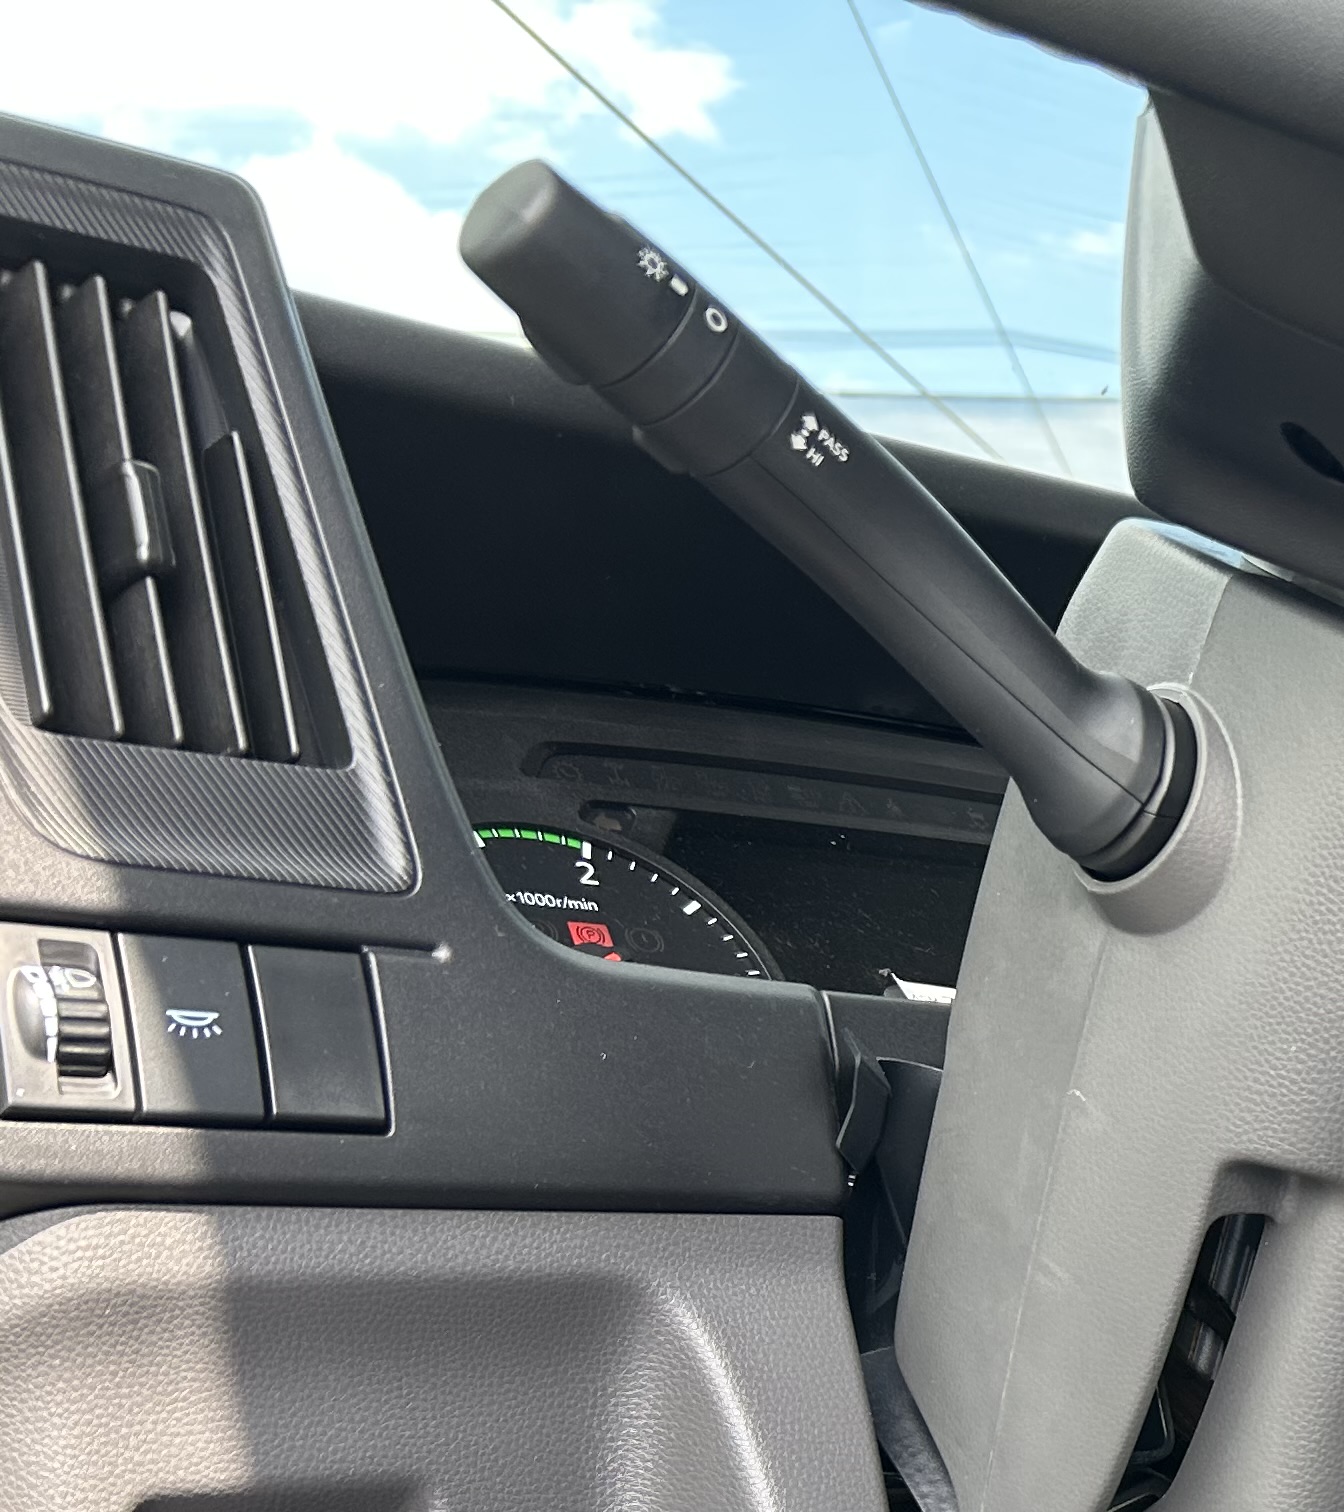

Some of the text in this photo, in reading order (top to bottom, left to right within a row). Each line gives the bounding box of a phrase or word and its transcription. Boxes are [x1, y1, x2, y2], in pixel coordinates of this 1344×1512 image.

[806, 447, 825, 466] HI
[818, 427, 850, 462] PASS
[575, 861, 600, 886] 2
